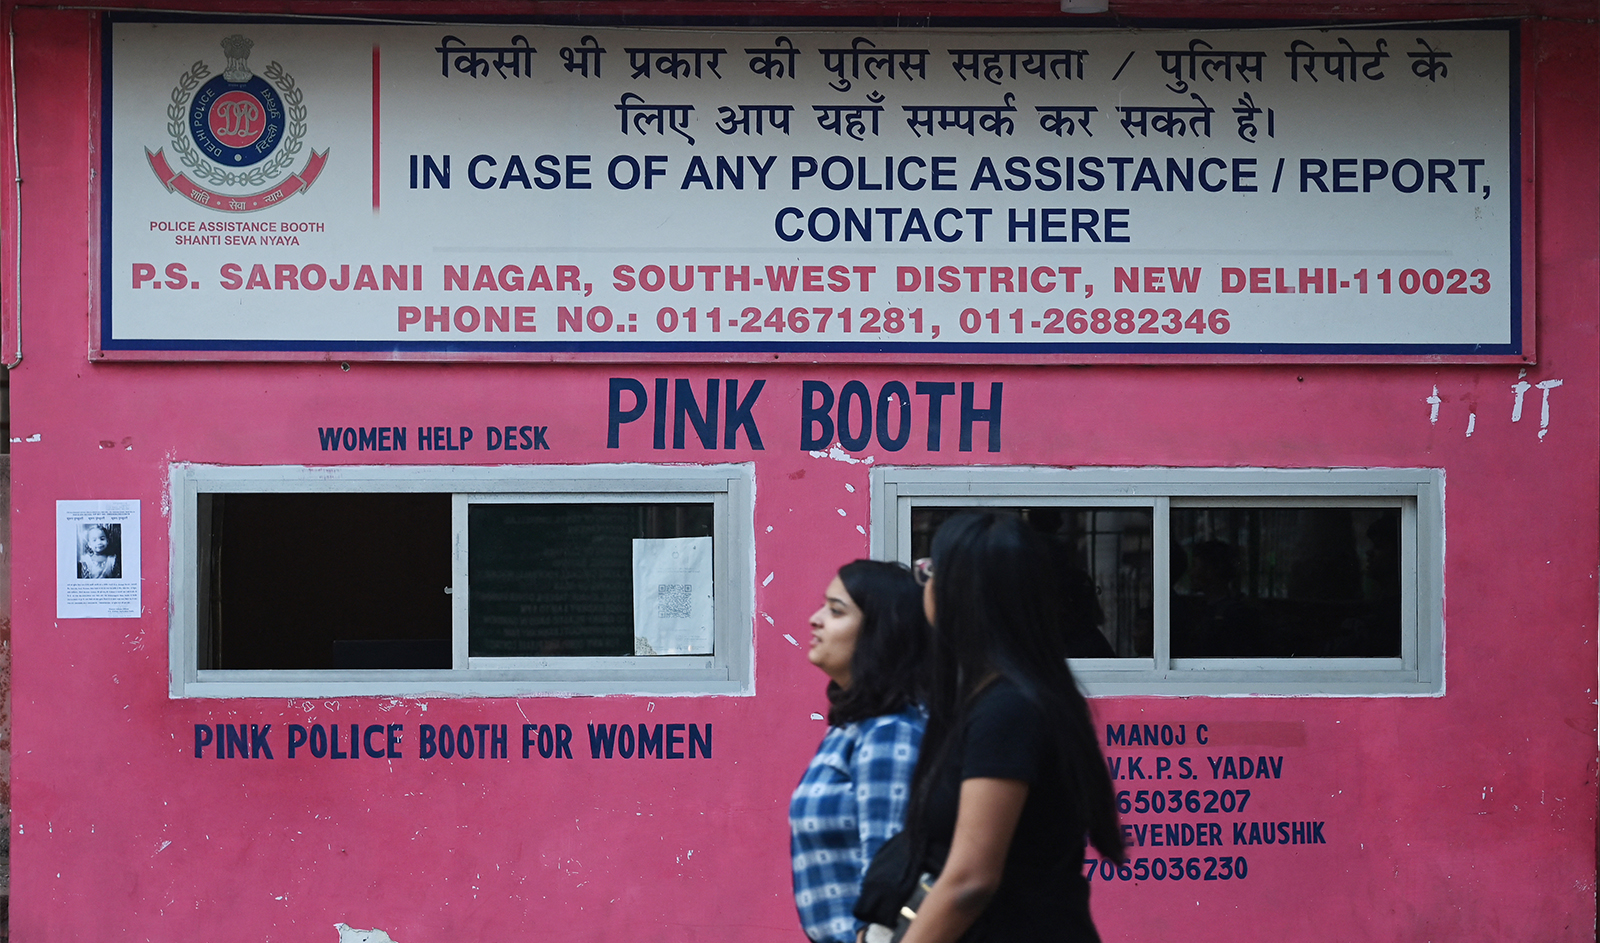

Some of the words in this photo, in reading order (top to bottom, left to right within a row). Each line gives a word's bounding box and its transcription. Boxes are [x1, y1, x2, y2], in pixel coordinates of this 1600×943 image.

[435, 35, 537, 79] किसी
[559, 35, 607, 78] भी
[623, 48, 727, 80] प्रकार
[744, 36, 801, 79] की
[818, 36, 930, 90] पुलिस
[947, 49, 1089, 82] सहायता
[1155, 38, 1267, 93] पुलिस
[1284, 38, 1390, 81] रिपोर्ट
[1407, 38, 1453, 80] के
[194, 88, 215, 127] POLICE
[614, 92, 696, 146] लिए
[715, 105, 795, 136] आप
[812, 90, 885, 141] यहाँ
[901, 92, 1017, 138] सम्पर्क
[1034, 106, 1098, 138] कर
[1115, 93, 1215, 139] सकते
[196, 129, 222, 157] DELHI
[409, 155, 450, 190] IN
[468, 154, 591, 190] CASE
[608, 155, 668, 190] OF
[680, 156, 777, 190] ANY
[792, 155, 957, 191] POLICE
[970, 156, 1258, 193] ASSISTANCE
[1272, 158, 1286, 193] /
[1300, 158, 1491, 200] REPORT,
[228, 198, 247, 211] सेवा
[263, 189, 284, 203] न्याय
[150, 221, 195, 232] POLICE
[199, 221, 277, 233] ASSISTANCE
[281, 222, 325, 233] BOOTH
[775, 207, 992, 242] CONTACT
[1008, 208, 1131, 242] HERE
[175, 235, 221, 246] SHANTI
[225, 235, 257, 246] SEVA
[260, 235, 300, 246] NYAYA
[132, 263, 199, 290] P.S.
[220, 263, 422, 291] SAROJANI
[444, 265, 593, 298] NAGAR,
[613, 265, 876, 293] SOUTH-WEST
[897, 266, 1093, 299] DISTRICT,
[1114, 267, 1202, 294] NEW
[1221, 267, 1492, 295] DELHI-110023
[397, 306, 536, 333] PHONE
[558, 306, 638, 334] NO.:
[656, 307, 940, 340] 011-24671281,
[960, 308, 1231, 335] 011-26882346
[607, 378, 766, 450] PINK
[801, 380, 1004, 452] BOOTH
[318, 427, 406, 452] WOMEN
[418, 427, 473, 451] HELP
[487, 426, 550, 451] DESK
[194, 724, 274, 760] PINK
[288, 724, 404, 760] POLICE
[420, 724, 508, 760] BOOTH
[523, 724, 573, 760] FOR
[588, 724, 713, 760] WOMEN
[1106, 724, 1186, 746] MANOJ
[1207, 756, 1283, 780] YADAV
[1116, 790, 1251, 814] 65036207
[1120, 823, 1223, 847] EVENDER
[1233, 821, 1327, 846] KAUSHIK
[1084, 857, 1248, 881] 7065036230
